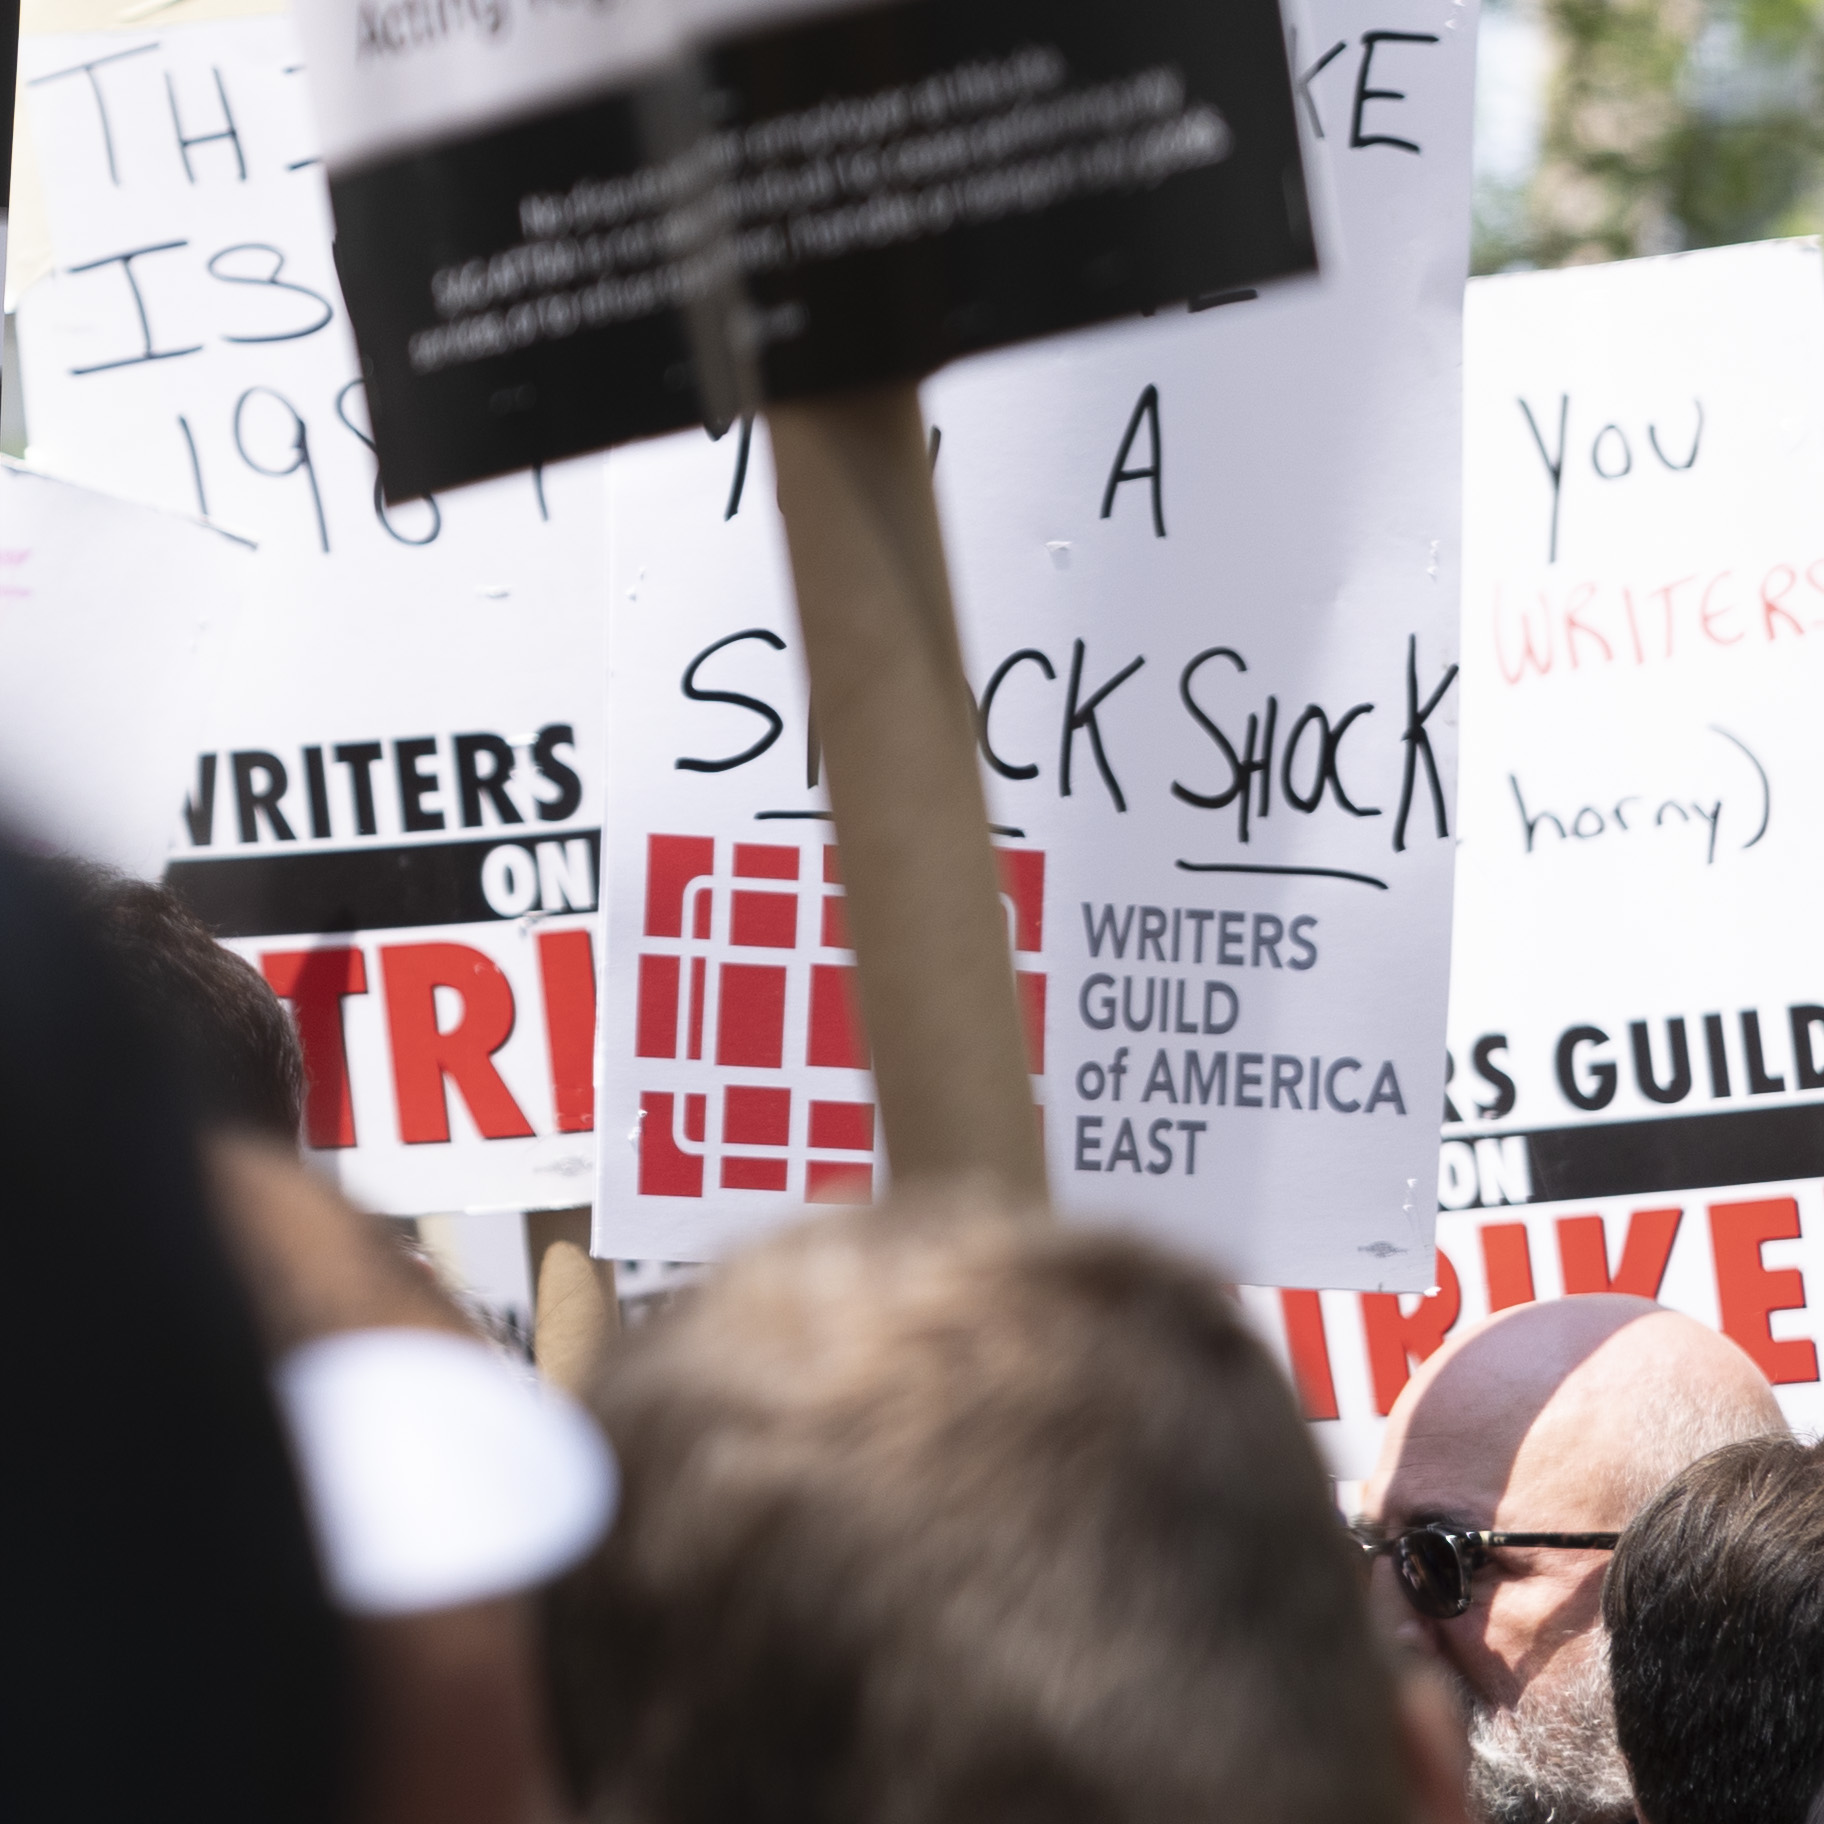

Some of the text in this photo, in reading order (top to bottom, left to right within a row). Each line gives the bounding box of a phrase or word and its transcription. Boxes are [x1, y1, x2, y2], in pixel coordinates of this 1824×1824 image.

[26, 40, 322, 187] TH
[66, 239, 334, 377] IS
[1100, 383, 1167, 539] A
[1170, 633, 1459, 852] SHOCK
[479, 838, 595, 919] ON
[1081, 902, 1319, 971] WRITERS
[1078, 973, 1240, 1036] GUILD
[1075, 1047, 1128, 1103] of
[1140, 1052, 1408, 1116] AMERICA
[1555, 1003, 1824, 1112] GUILD
[1074, 1115, 1208, 1176] EAST
[1440, 1134, 1534, 1212] ON
